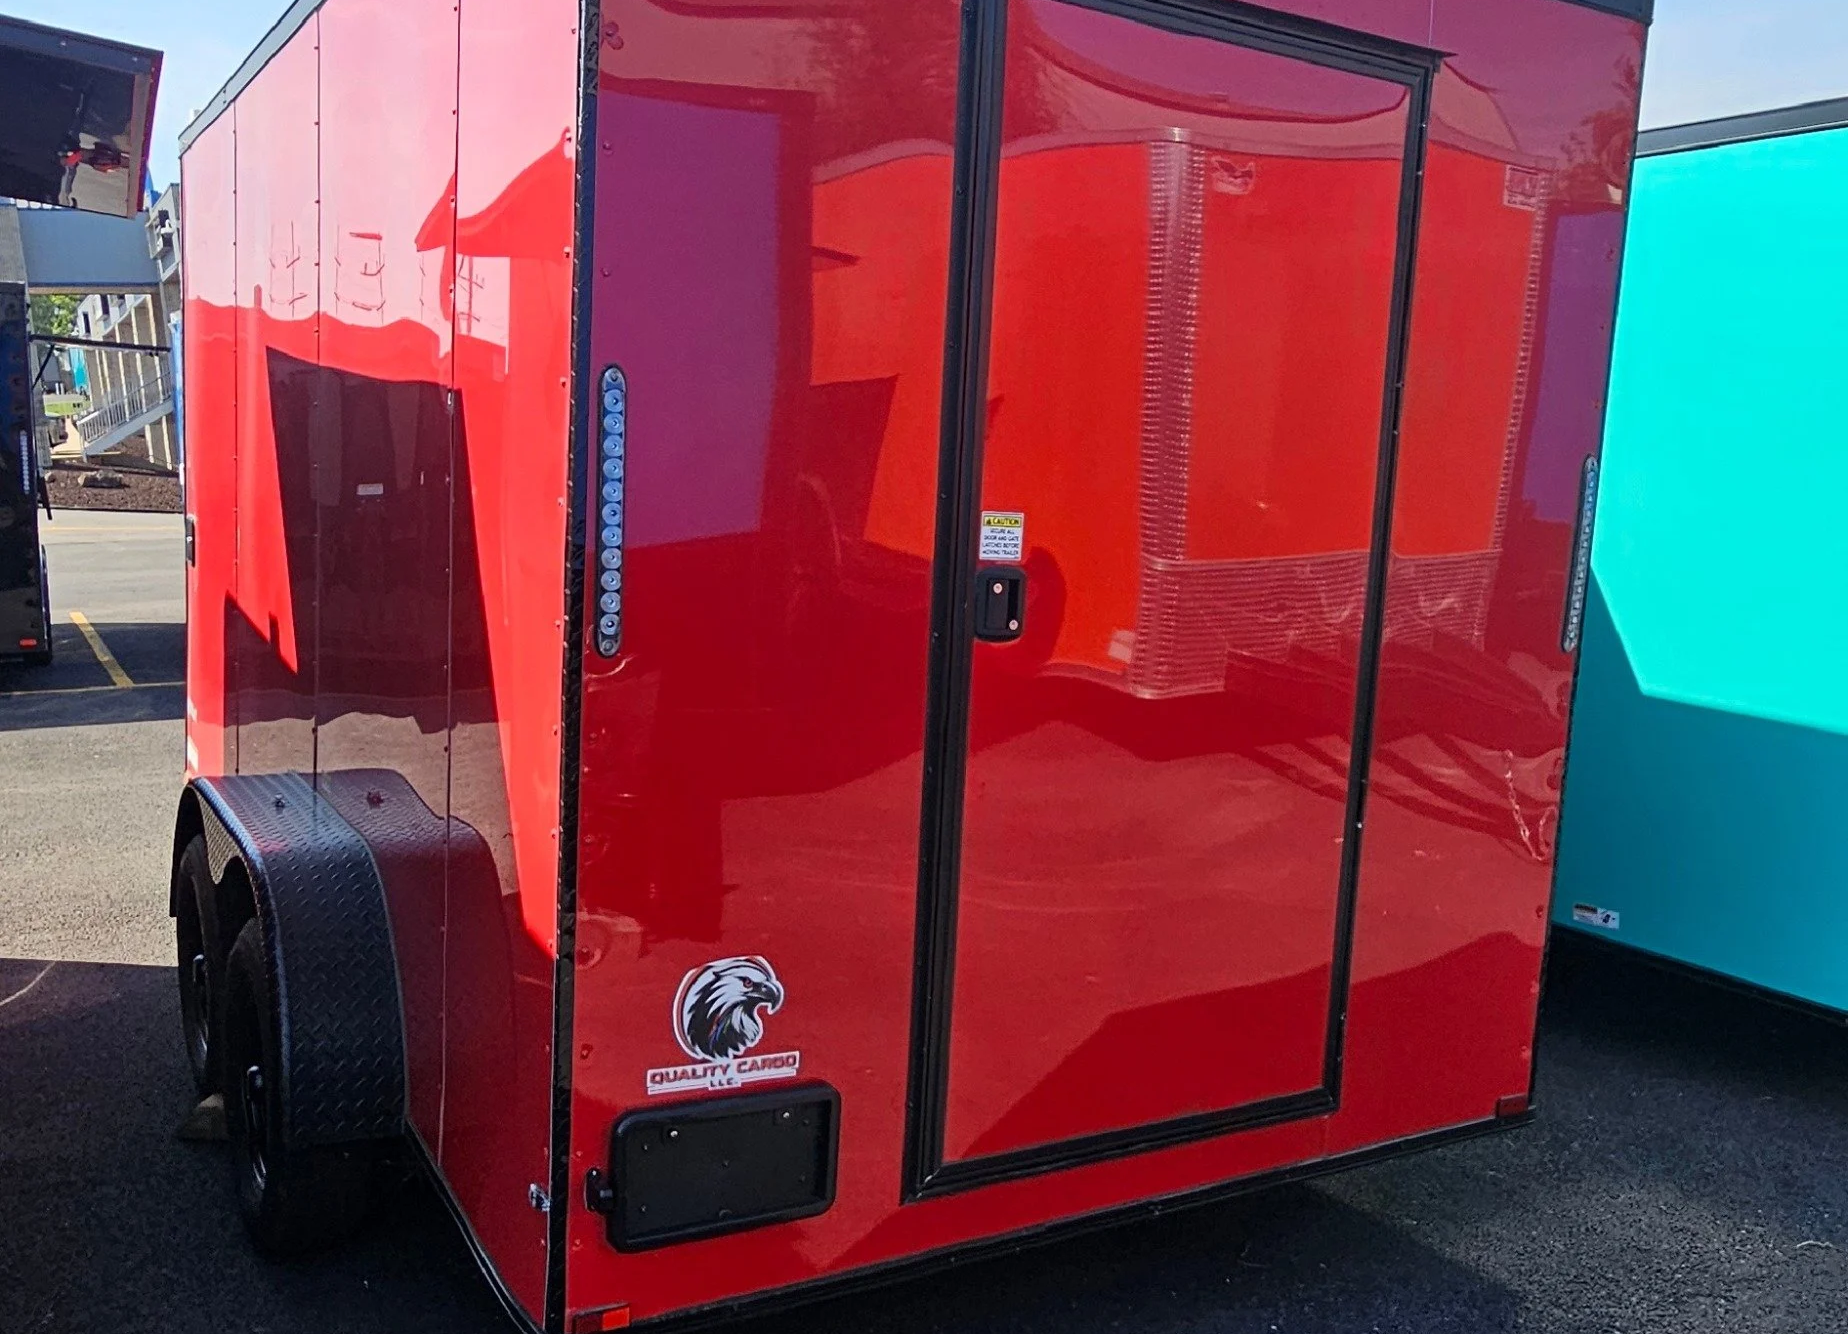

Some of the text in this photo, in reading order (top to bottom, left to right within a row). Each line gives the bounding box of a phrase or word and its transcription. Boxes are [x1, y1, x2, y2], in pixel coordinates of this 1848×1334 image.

[992, 517, 1019, 525] CAUTION
[650, 1054, 797, 1085] QUALITY CARGO
